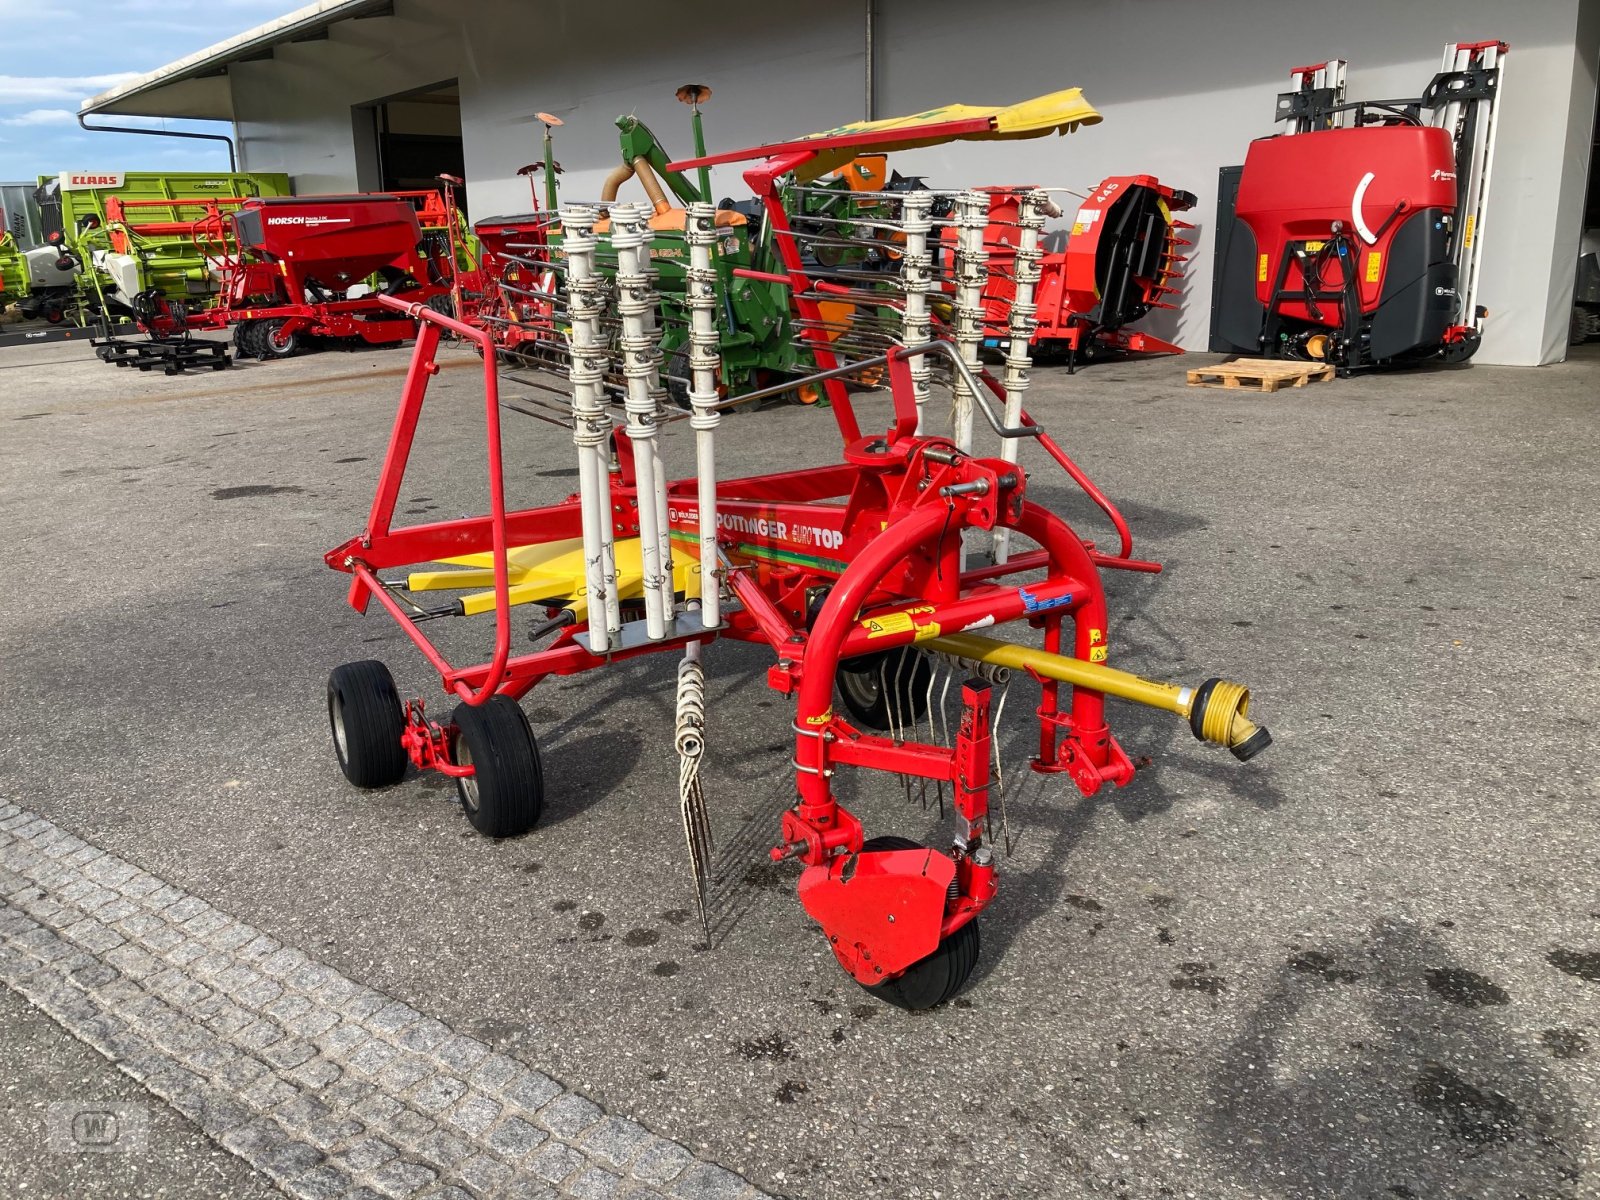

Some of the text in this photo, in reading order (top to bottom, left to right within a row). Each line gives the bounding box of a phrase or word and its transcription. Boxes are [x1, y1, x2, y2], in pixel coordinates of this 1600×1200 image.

[72, 176, 117, 185] CLAAS
[1096, 183, 1119, 203] 445
[268, 216, 304, 226] HORSCH
[716, 512, 787, 541] PÖTTINGER
[812, 526, 844, 550] TOP
